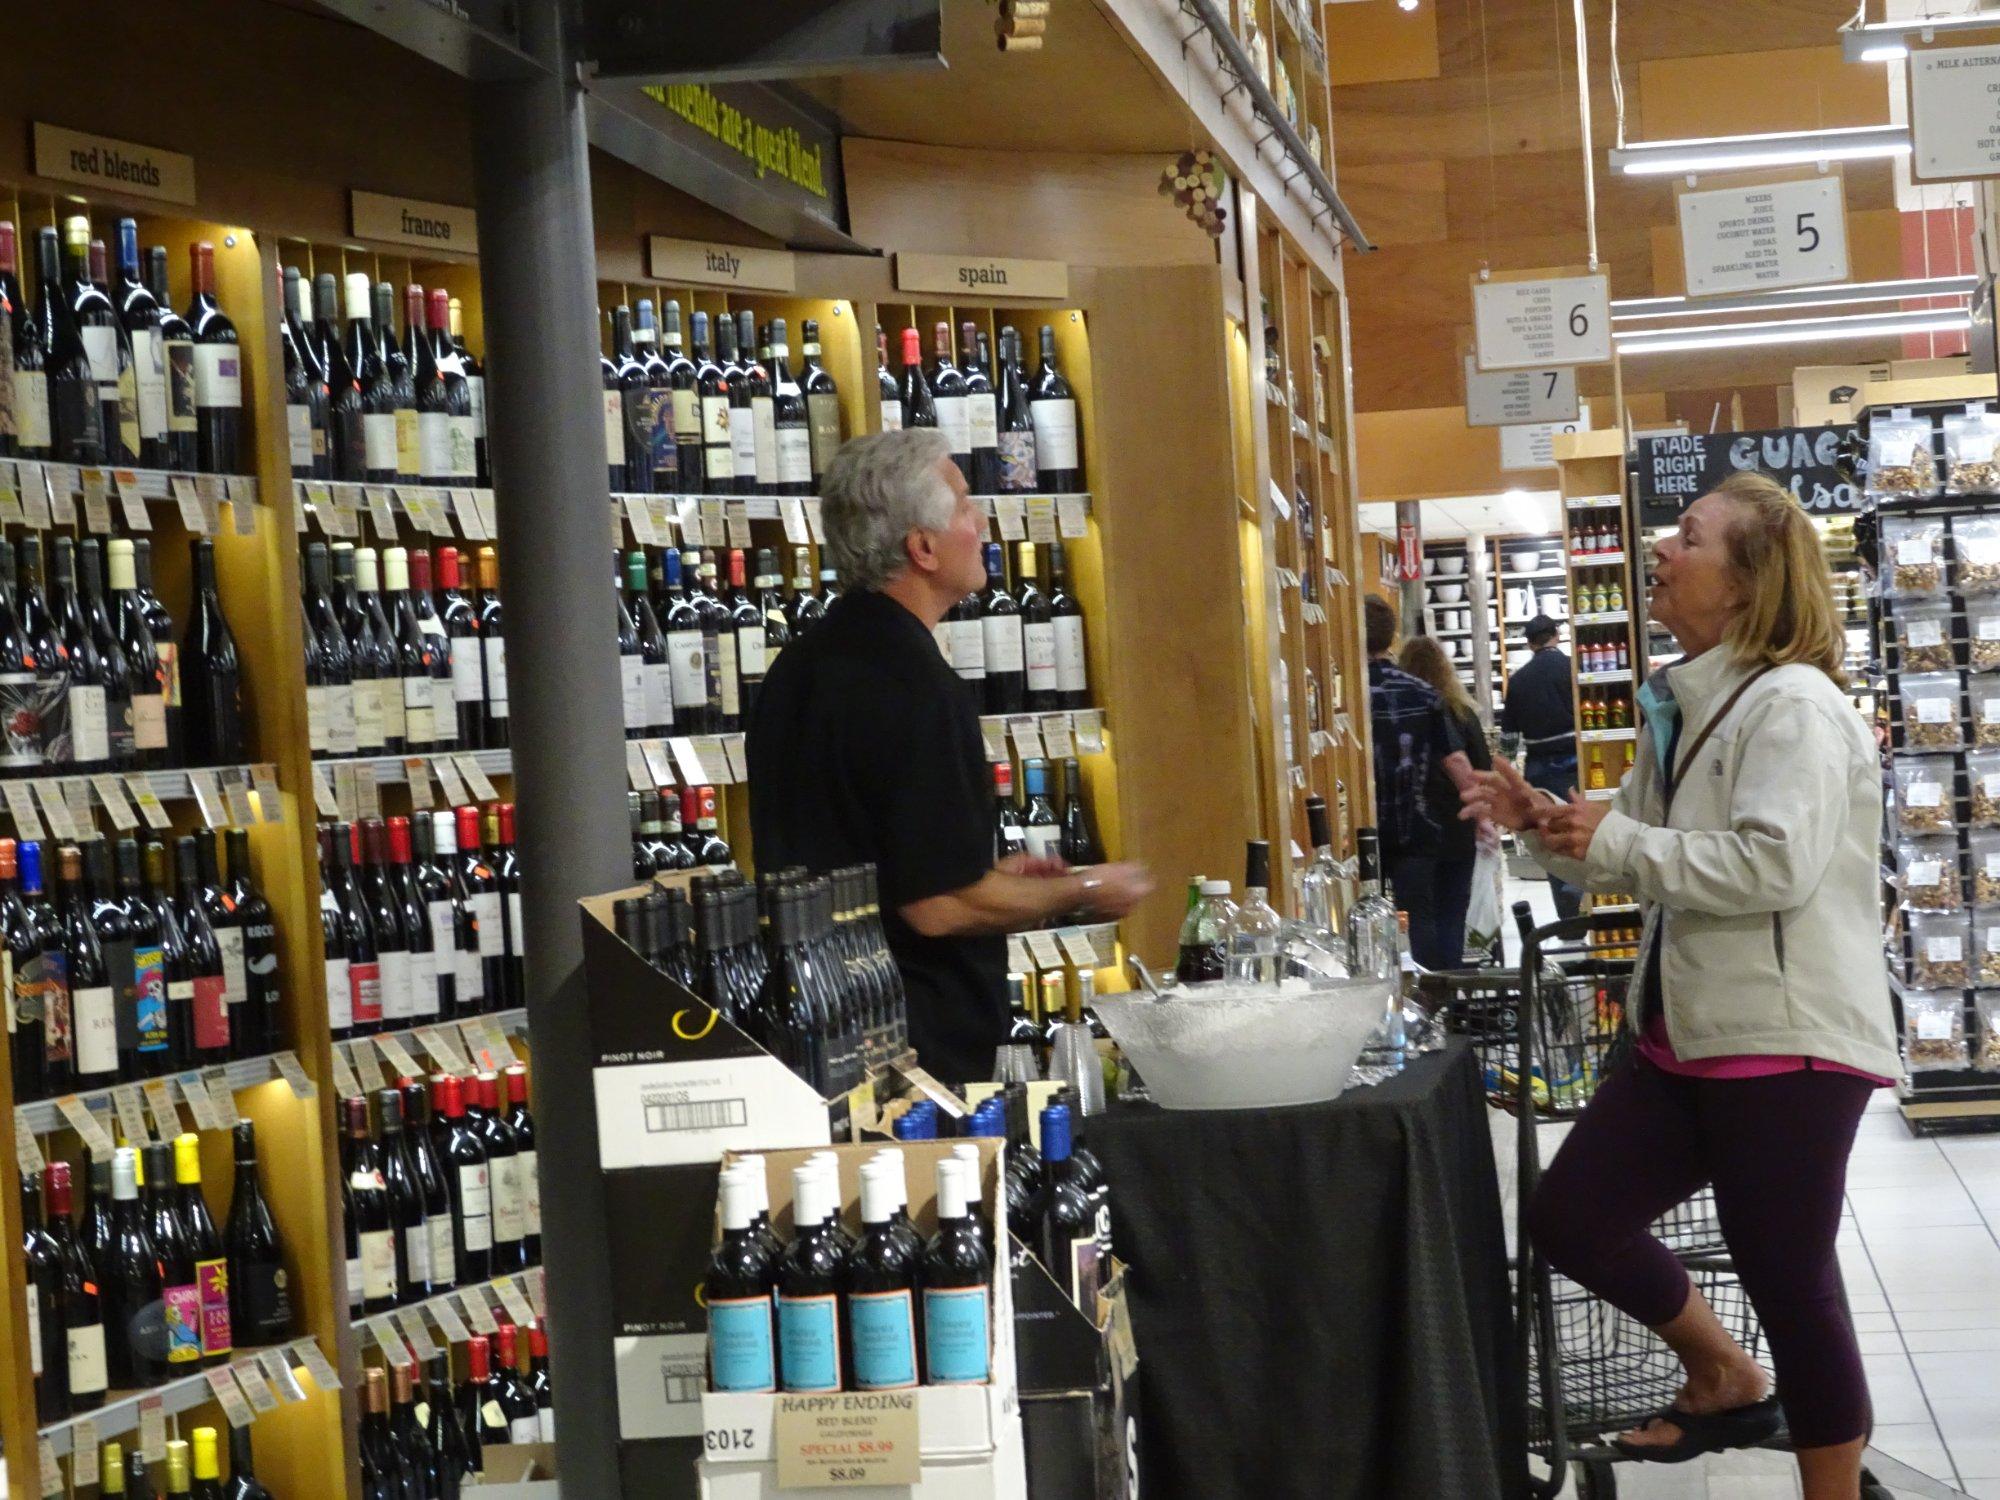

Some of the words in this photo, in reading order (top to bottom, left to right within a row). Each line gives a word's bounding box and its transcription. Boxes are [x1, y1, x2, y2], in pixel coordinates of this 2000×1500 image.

[1937, 59, 1960, 69] MILK
[70, 147, 99, 175] red
[103, 150, 161, 188] blends
[754, 124, 788, 180] great
[787, 126, 828, 198] blend.
[401, 208, 451, 240] france
[1718, 218, 1746, 229] SPORTS
[1747, 215, 1775, 226] DRINKS
[1717, 229, 1750, 240] COCONUT
[1752, 226, 1776, 237] WATER
[1753, 237, 1777, 247] SODAS
[1796, 212, 1820, 253] 5
[1763, 248, 1778, 257] TEA
[705, 249, 740, 279] italy
[1712, 262, 1752, 274] SPARKLING
[1755, 259, 1779, 270] WATER
[958, 264, 1008, 288] spain
[1755, 270, 1780, 280] WATER
[1569, 303, 1588, 337] 6
[1542, 371, 1557, 399] 7
[1651, 435, 1706, 456] MADE
[1653, 455, 1708, 476] RIGHT
[1654, 474, 1699, 495] HERE
[601, 1052, 635, 1063] PINOT
[636, 1050, 666, 1061] NOIR
[623, 1322, 656, 1332] PINOT
[659, 1321, 687, 1331] NOIR
[781, 1396, 839, 1413] HAPPY
[843, 1394, 913, 1411] ENDING
[816, 1417, 838, 1427] RED
[841, 1416, 879, 1426] BLEND
[800, 1443, 853, 1457] SPECIAL
